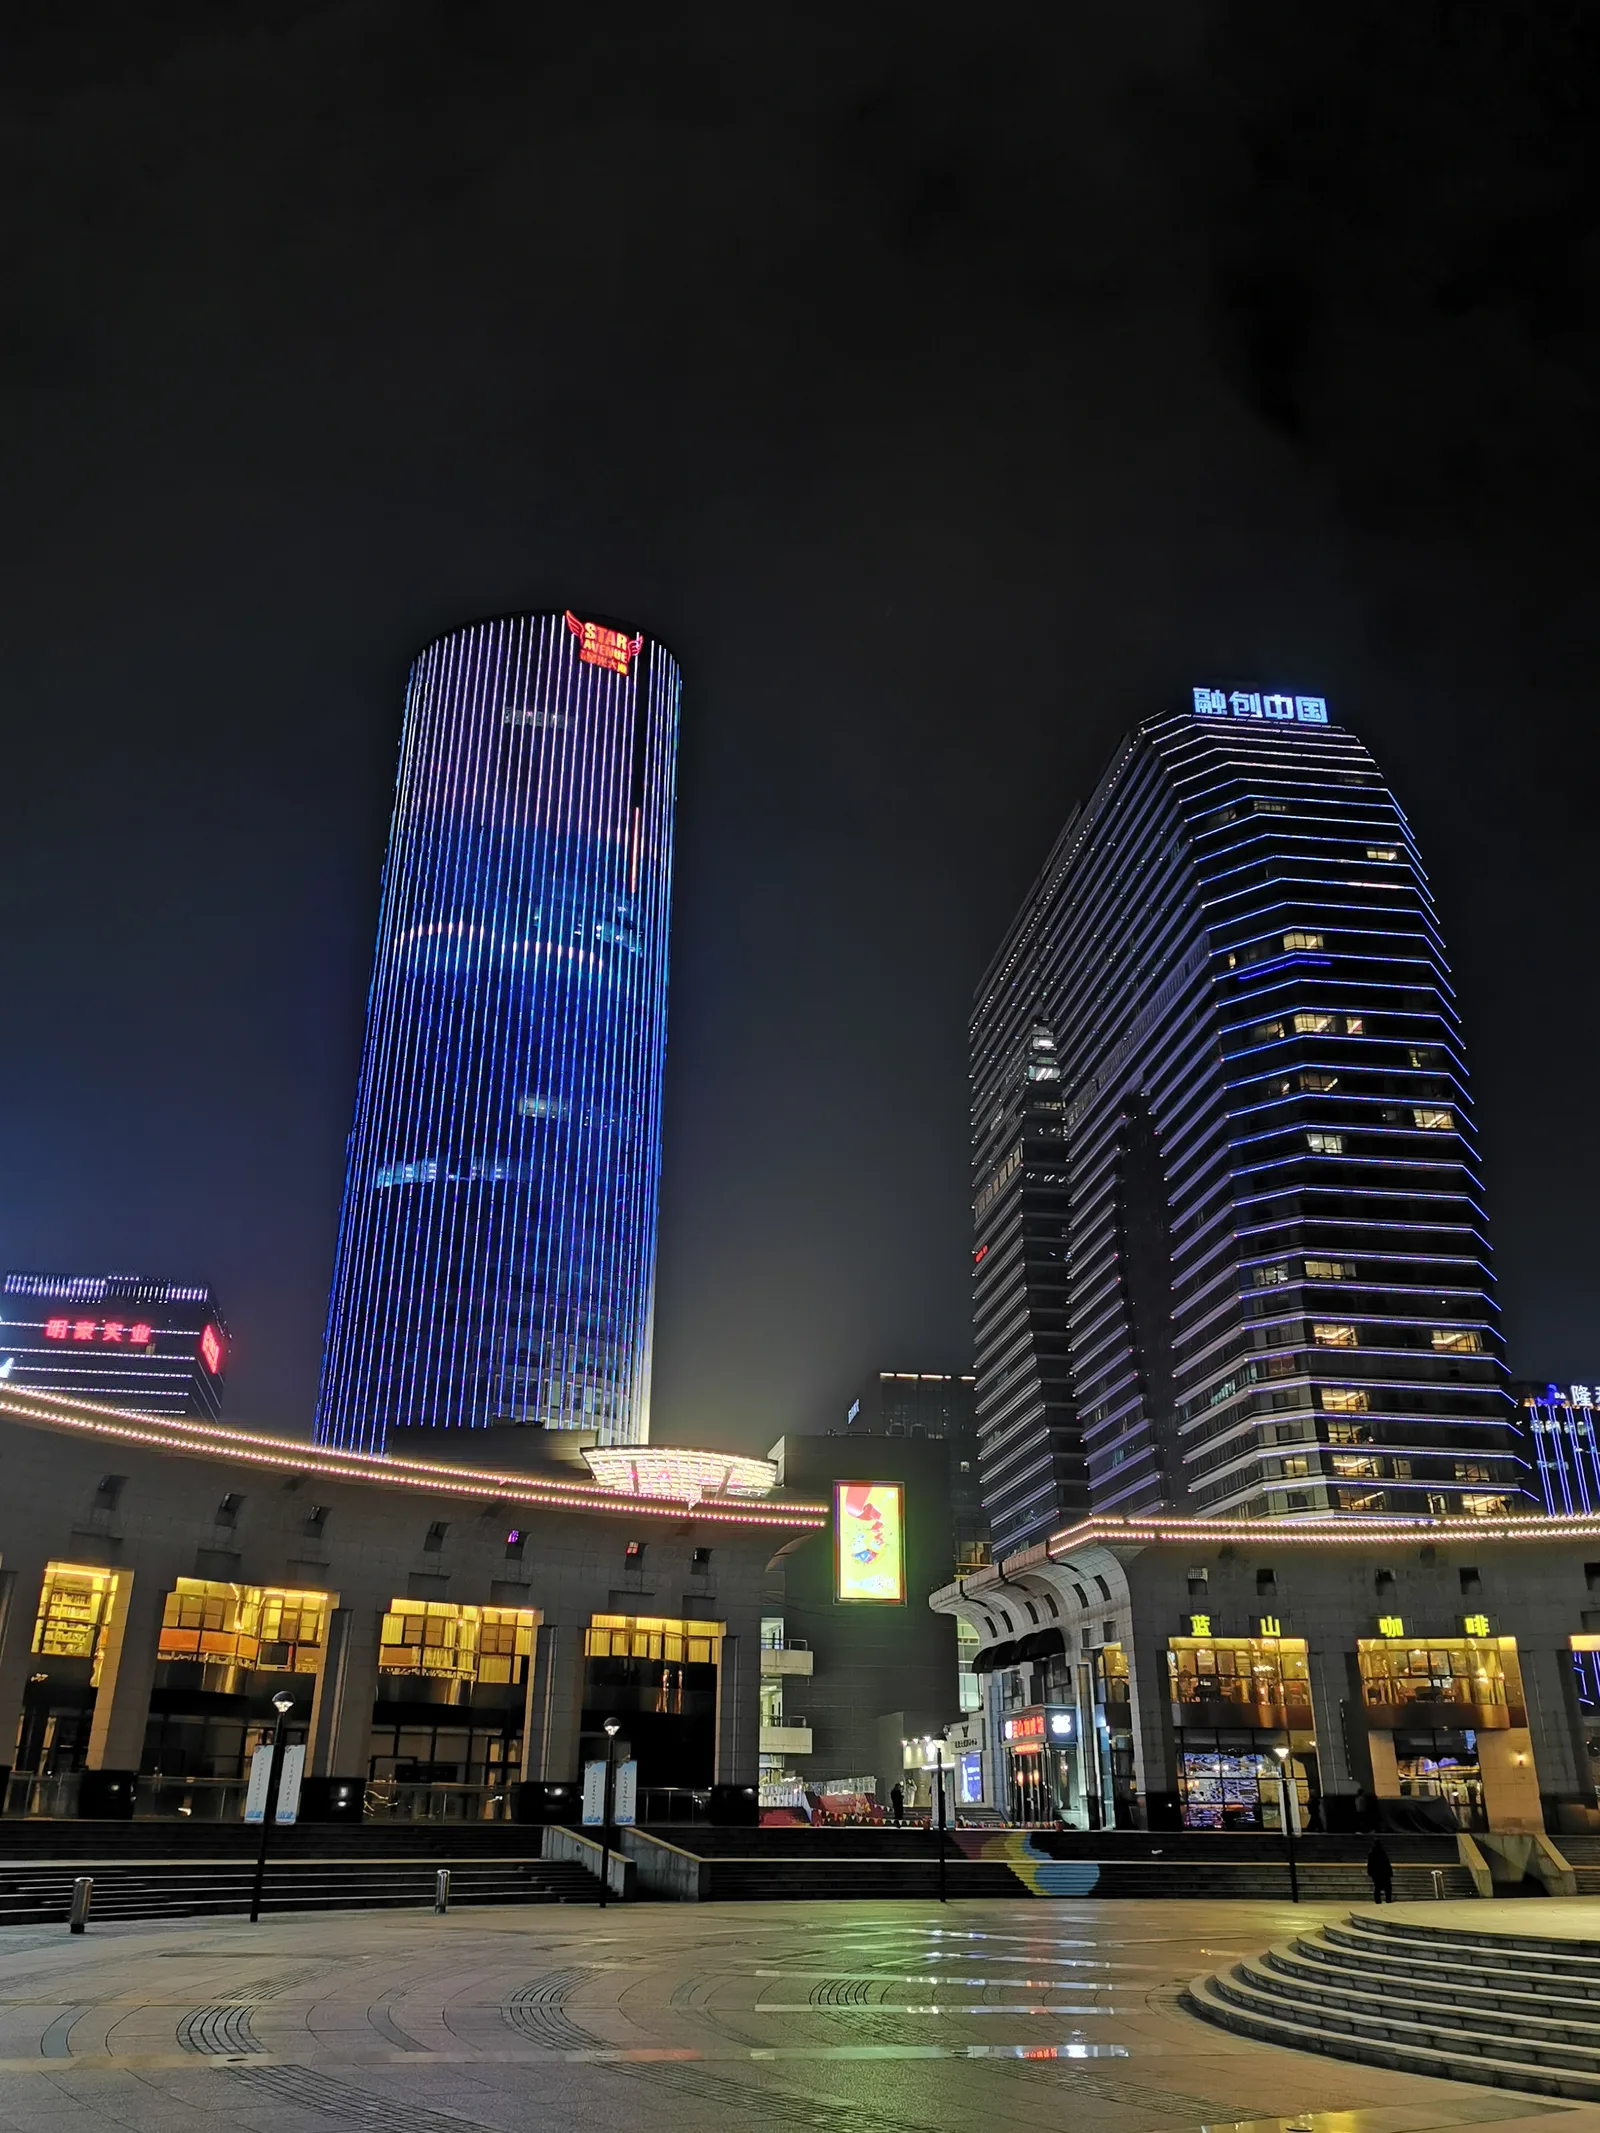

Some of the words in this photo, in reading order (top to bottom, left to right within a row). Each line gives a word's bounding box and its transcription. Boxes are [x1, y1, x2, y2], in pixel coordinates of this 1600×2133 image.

[585, 622, 628, 651] STAR
[583, 639, 628, 663] AVENUE
[1192, 687, 1328, 723] 融创中国
[46, 1319, 151, 1343] 明豪实业
[1570, 1385, 1600, 1406] 隆
[1190, 1614, 1490, 1638] 蓝山咖啡
